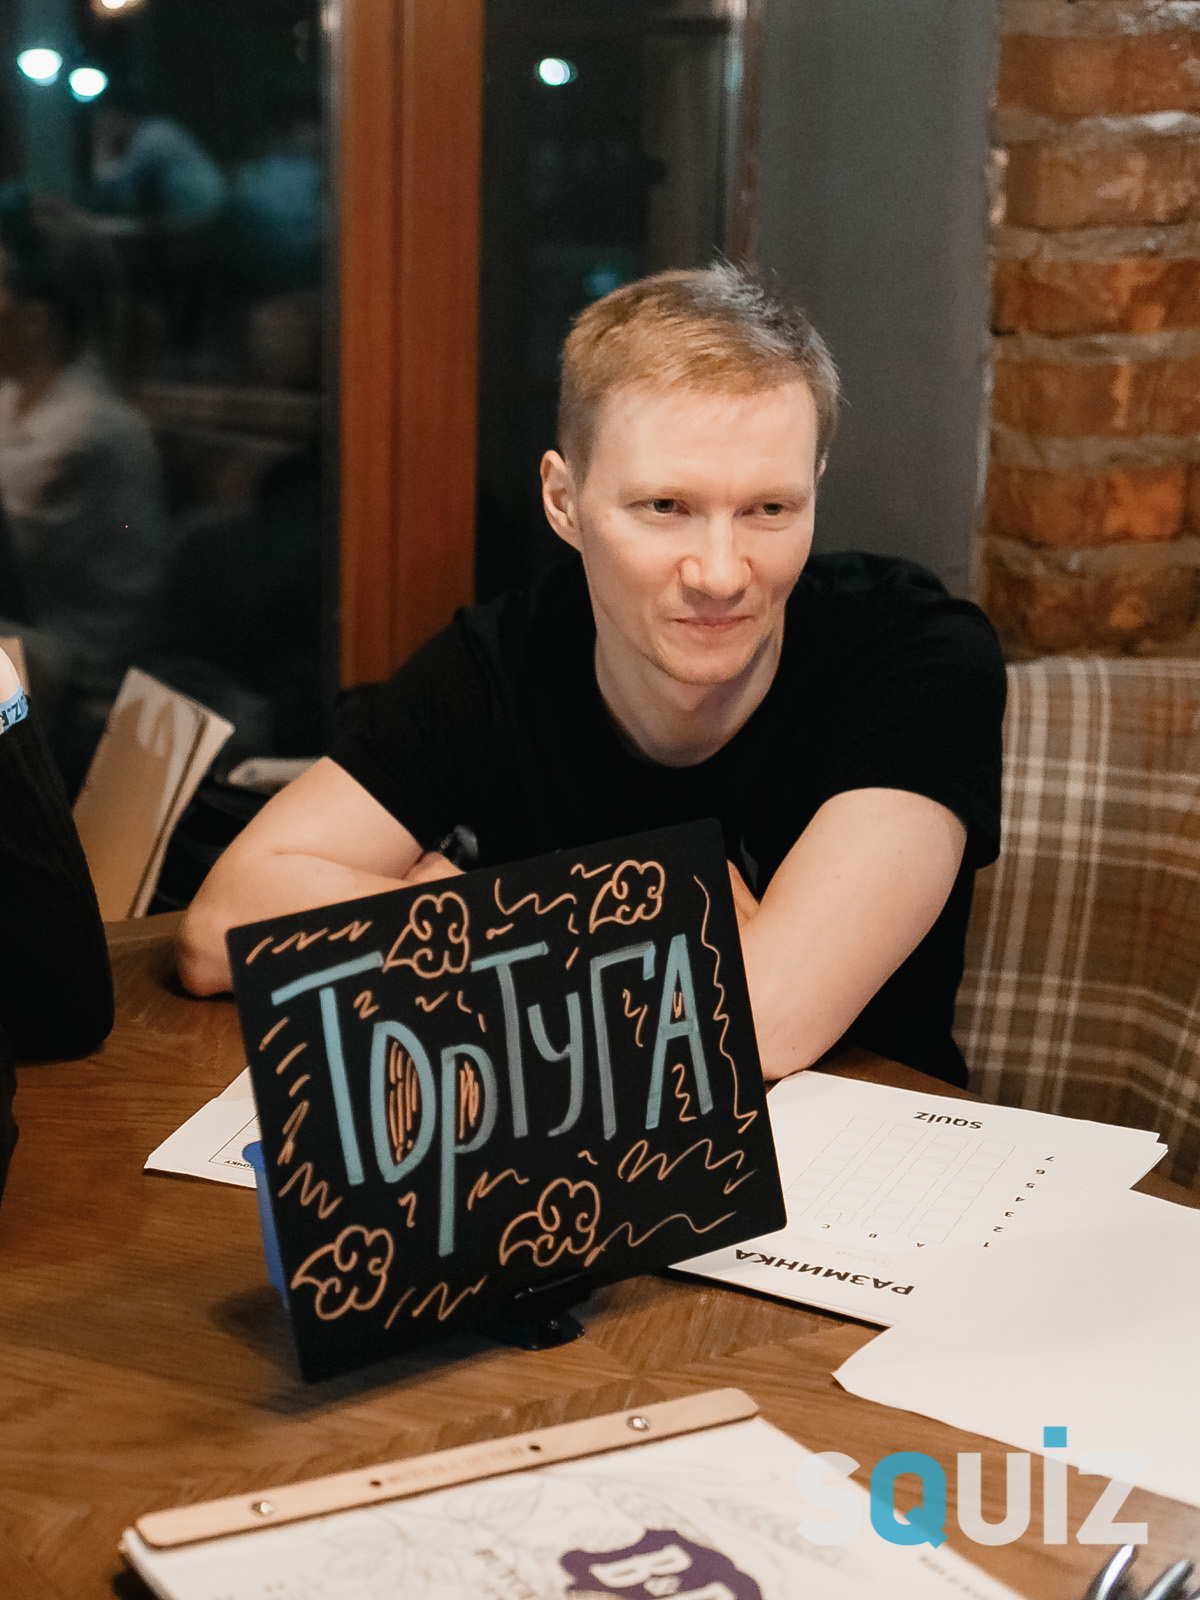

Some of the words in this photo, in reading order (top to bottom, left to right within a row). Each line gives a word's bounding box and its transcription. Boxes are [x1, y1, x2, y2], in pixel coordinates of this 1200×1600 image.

[1015, 1195, 1026, 1203] 4
[1004, 1210, 1015, 1218] 3
[993, 1225, 1004, 1233] 2
[735, 1249, 915, 1295] РАЗМИНКА
